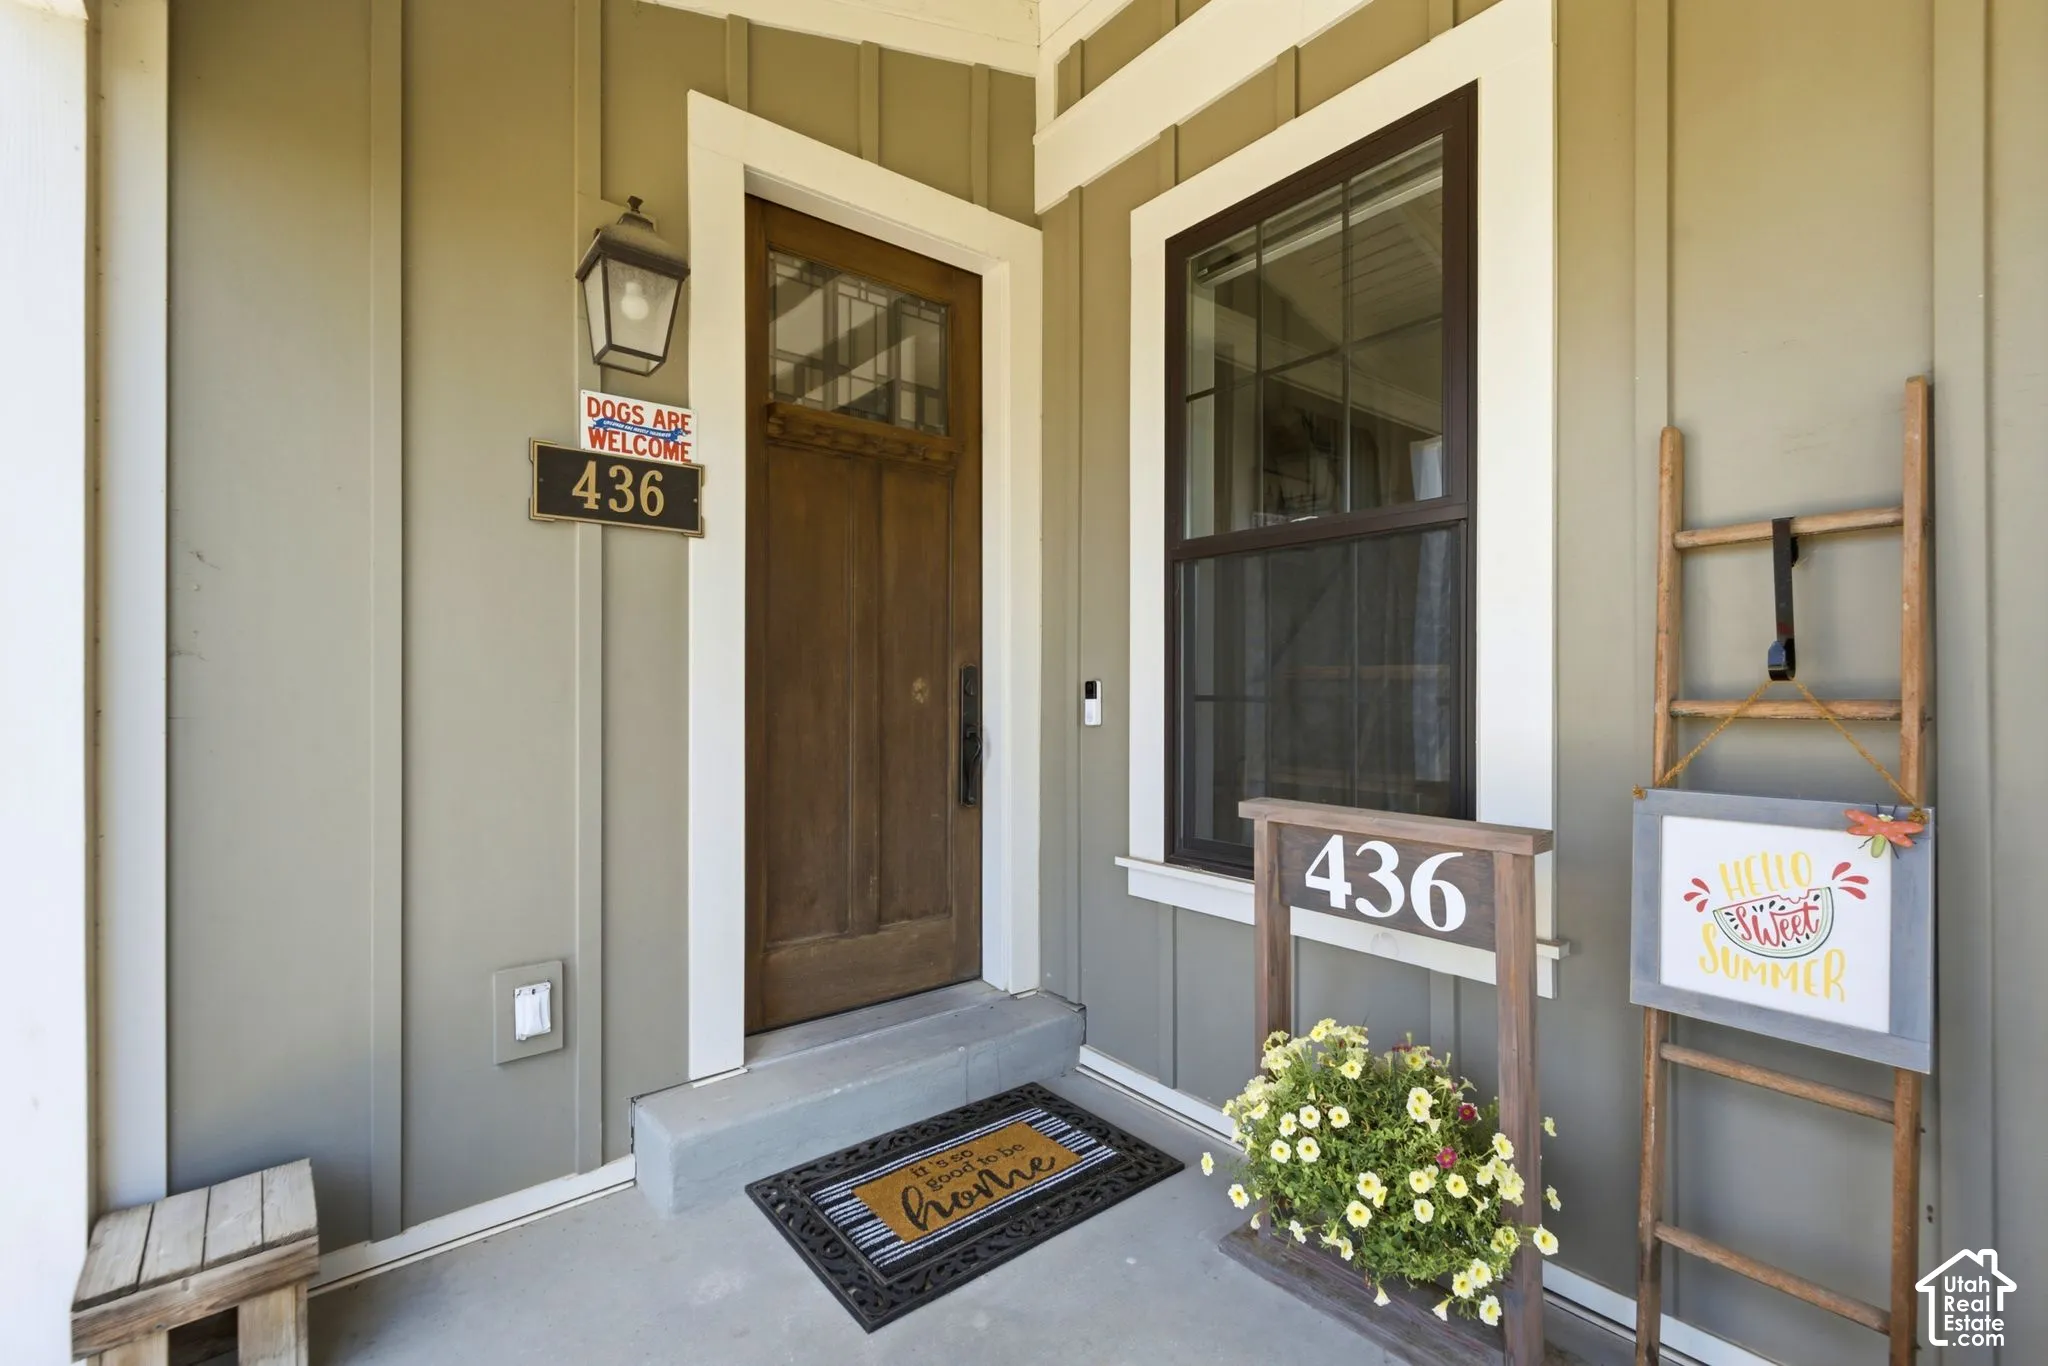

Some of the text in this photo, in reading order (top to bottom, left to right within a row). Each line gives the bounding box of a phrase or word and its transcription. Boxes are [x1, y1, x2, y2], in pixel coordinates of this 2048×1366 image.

[587, 396, 645, 425] DOGS
[653, 408, 692, 434] ARE
[588, 426, 692, 463] WELCOME
[572, 460, 664, 517] 436
[1305, 834, 1467, 932] 436
[1718, 851, 1812, 901] HELLO
[1699, 922, 1846, 1004] SUMMER
[909, 1149, 974, 1179] it's so
[925, 1141, 1025, 1192] good to be
[901, 1156, 1056, 1231] home
